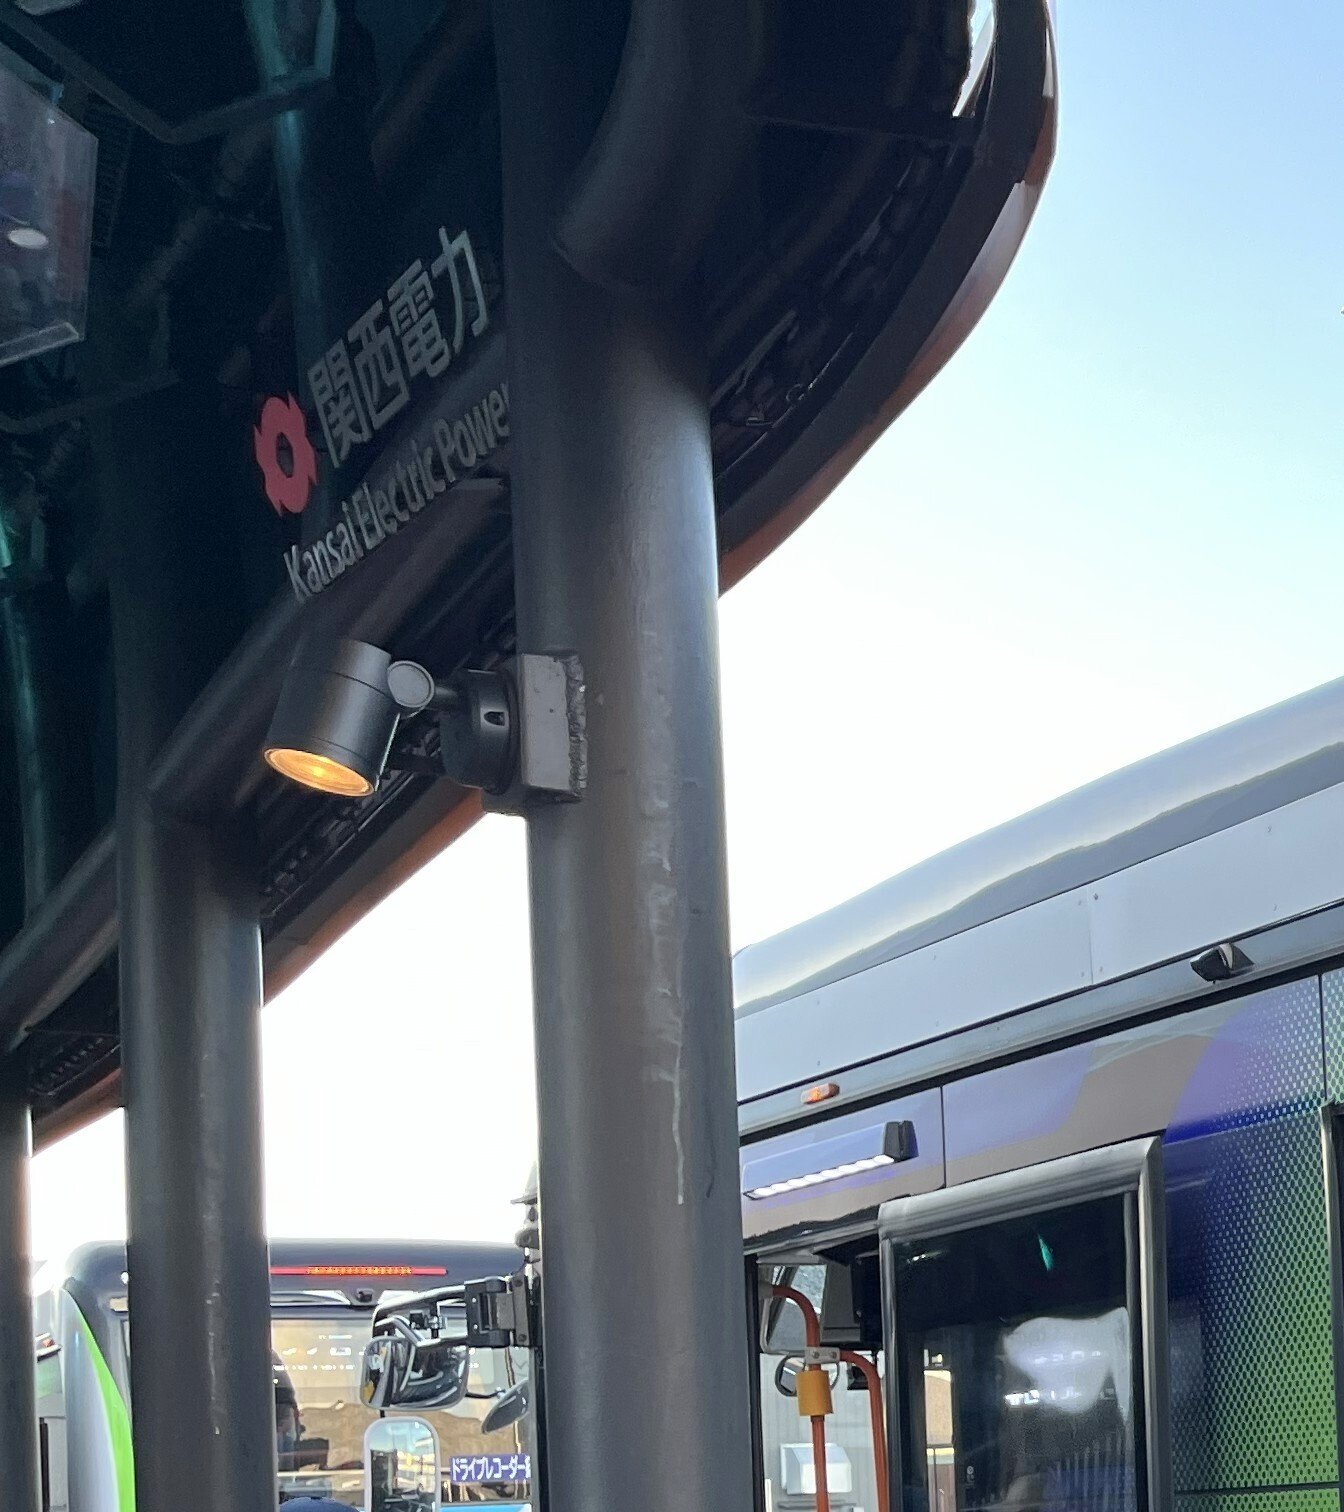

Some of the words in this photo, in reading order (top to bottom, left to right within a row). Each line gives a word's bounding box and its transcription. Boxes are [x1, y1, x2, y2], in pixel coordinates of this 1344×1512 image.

[308, 225, 490, 468] 関西電力
[283, 501, 364, 603] Kansai
[353, 440, 446, 549] Electric
